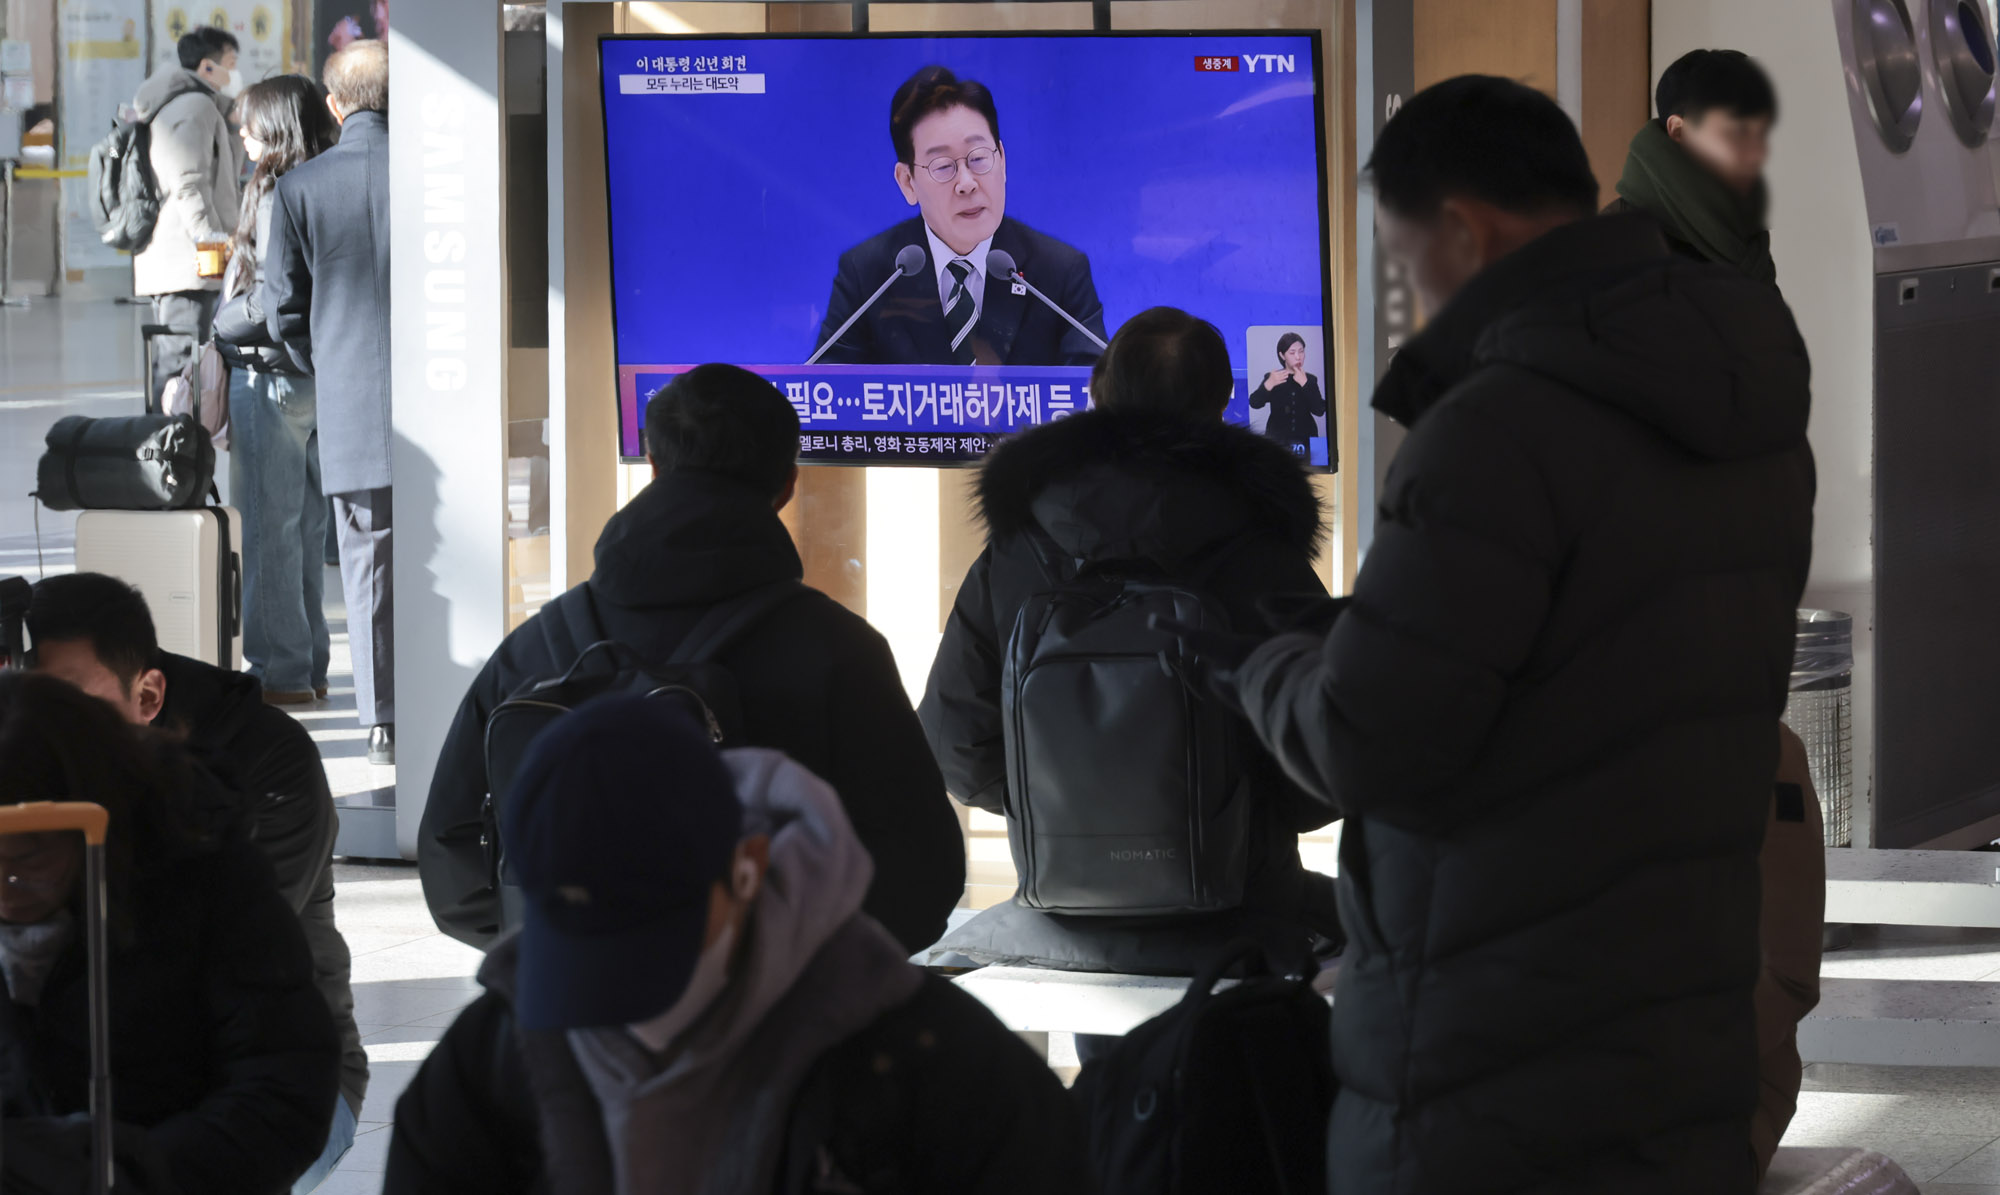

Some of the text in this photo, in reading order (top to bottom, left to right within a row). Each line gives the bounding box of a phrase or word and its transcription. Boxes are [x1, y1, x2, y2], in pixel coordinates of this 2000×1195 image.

[636, 55, 747, 73] 이 대통령 신년 회견
[1203, 58, 1232, 70] 생중계
[1242, 54, 1295, 73] YTN
[646, 76, 739, 91] 모두 누리는 대도약
[421, 93, 466, 391] SAMSUNG
[1048, 385, 1075, 422] 등
[800, 435, 838, 452] 멜로니
[841, 435, 872, 453] 총리,
[874, 436, 901, 453] 영화
[903, 436, 957, 454] 공동제작
[1110, 848, 1177, 861] NOMATIC
